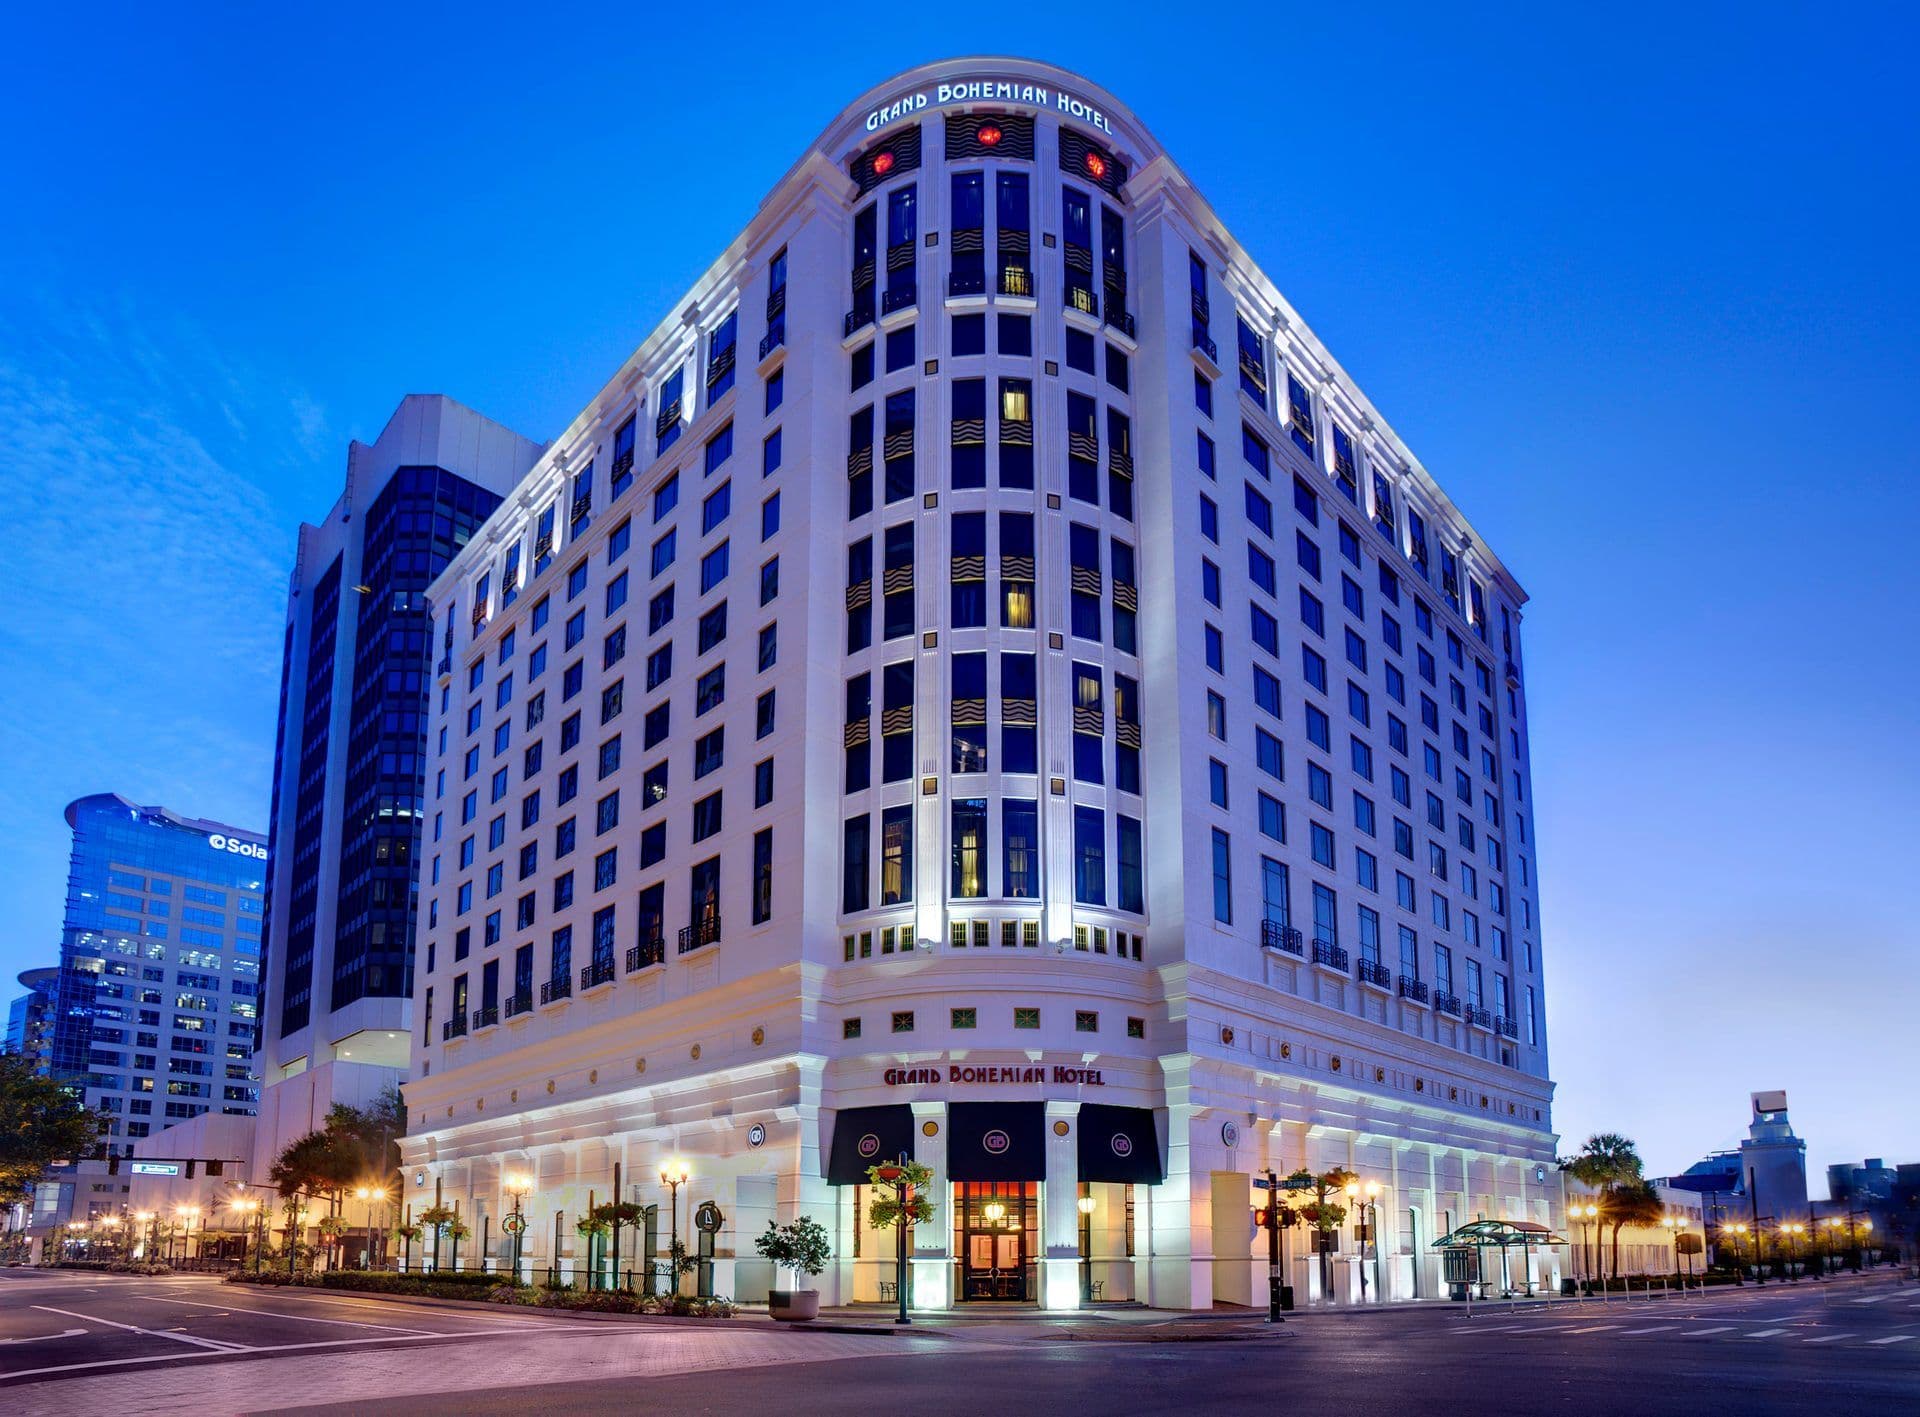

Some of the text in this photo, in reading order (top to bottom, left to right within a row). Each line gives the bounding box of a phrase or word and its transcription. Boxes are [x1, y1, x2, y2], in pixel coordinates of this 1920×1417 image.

[866, 82, 1112, 135] GRAND BOHEMIAN HOTEL
[884, 1066, 1105, 1086] GRAND BOHEMIAN HOTEL
